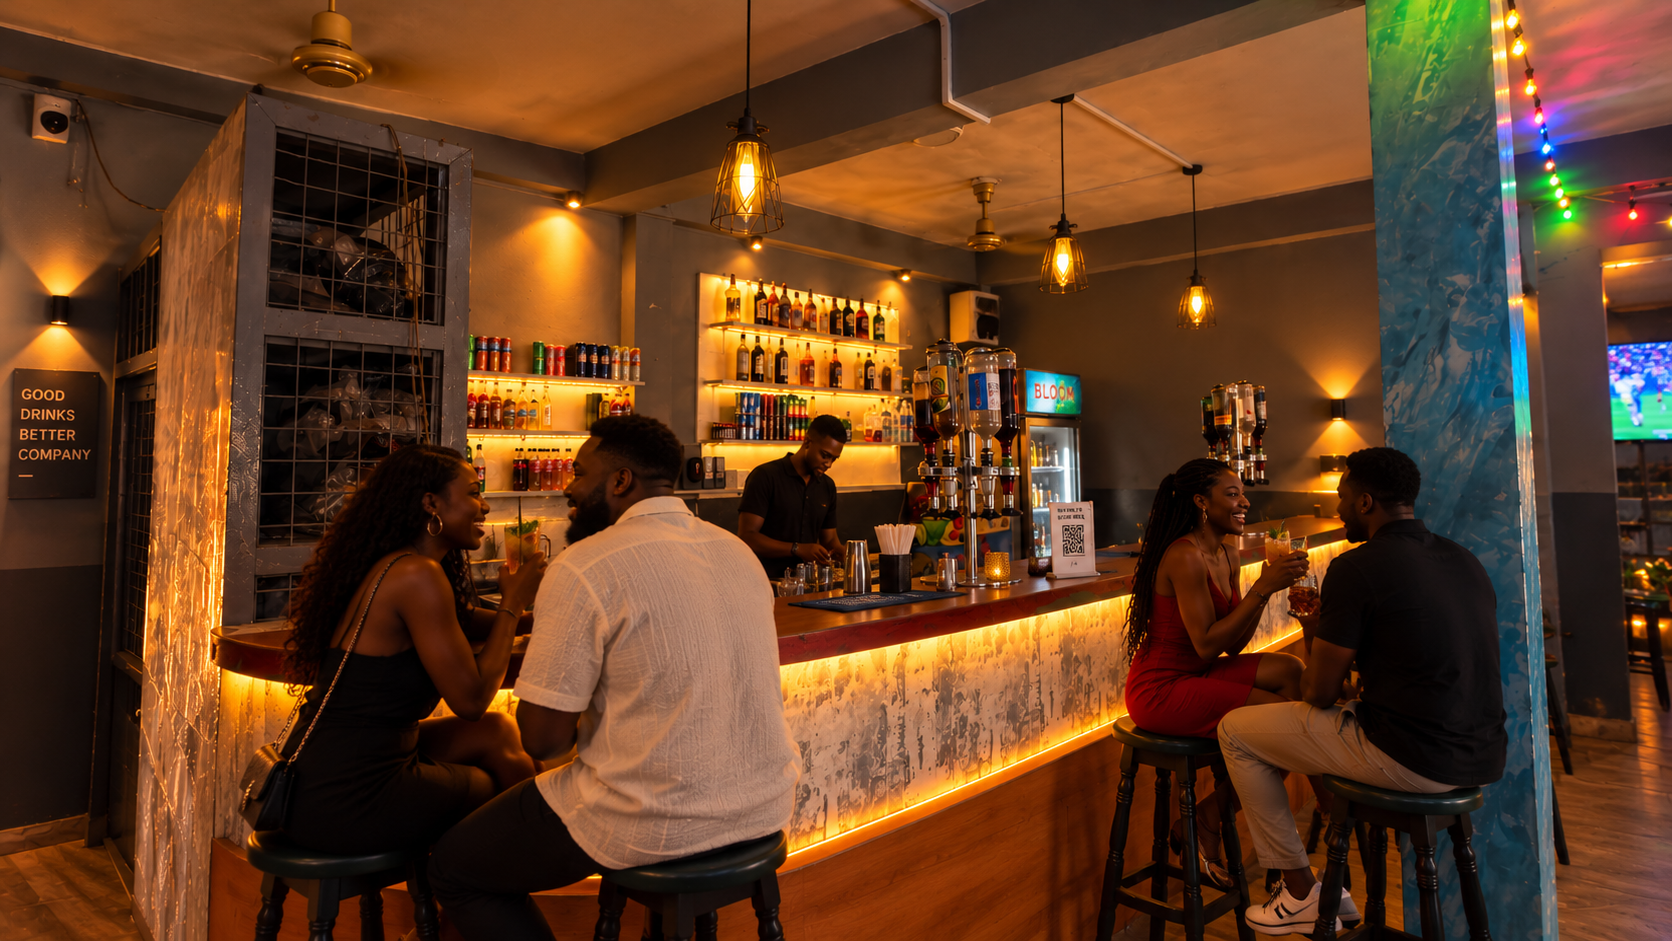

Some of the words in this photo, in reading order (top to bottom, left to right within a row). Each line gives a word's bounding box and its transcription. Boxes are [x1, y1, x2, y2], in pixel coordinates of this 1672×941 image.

[21, 388, 65, 401] GOOD
[1034, 382, 1075, 402] BLOOM
[20, 408, 75, 421] DRINKS
[19, 428, 76, 441] BETTER
[18, 448, 91, 461] COMPANY
